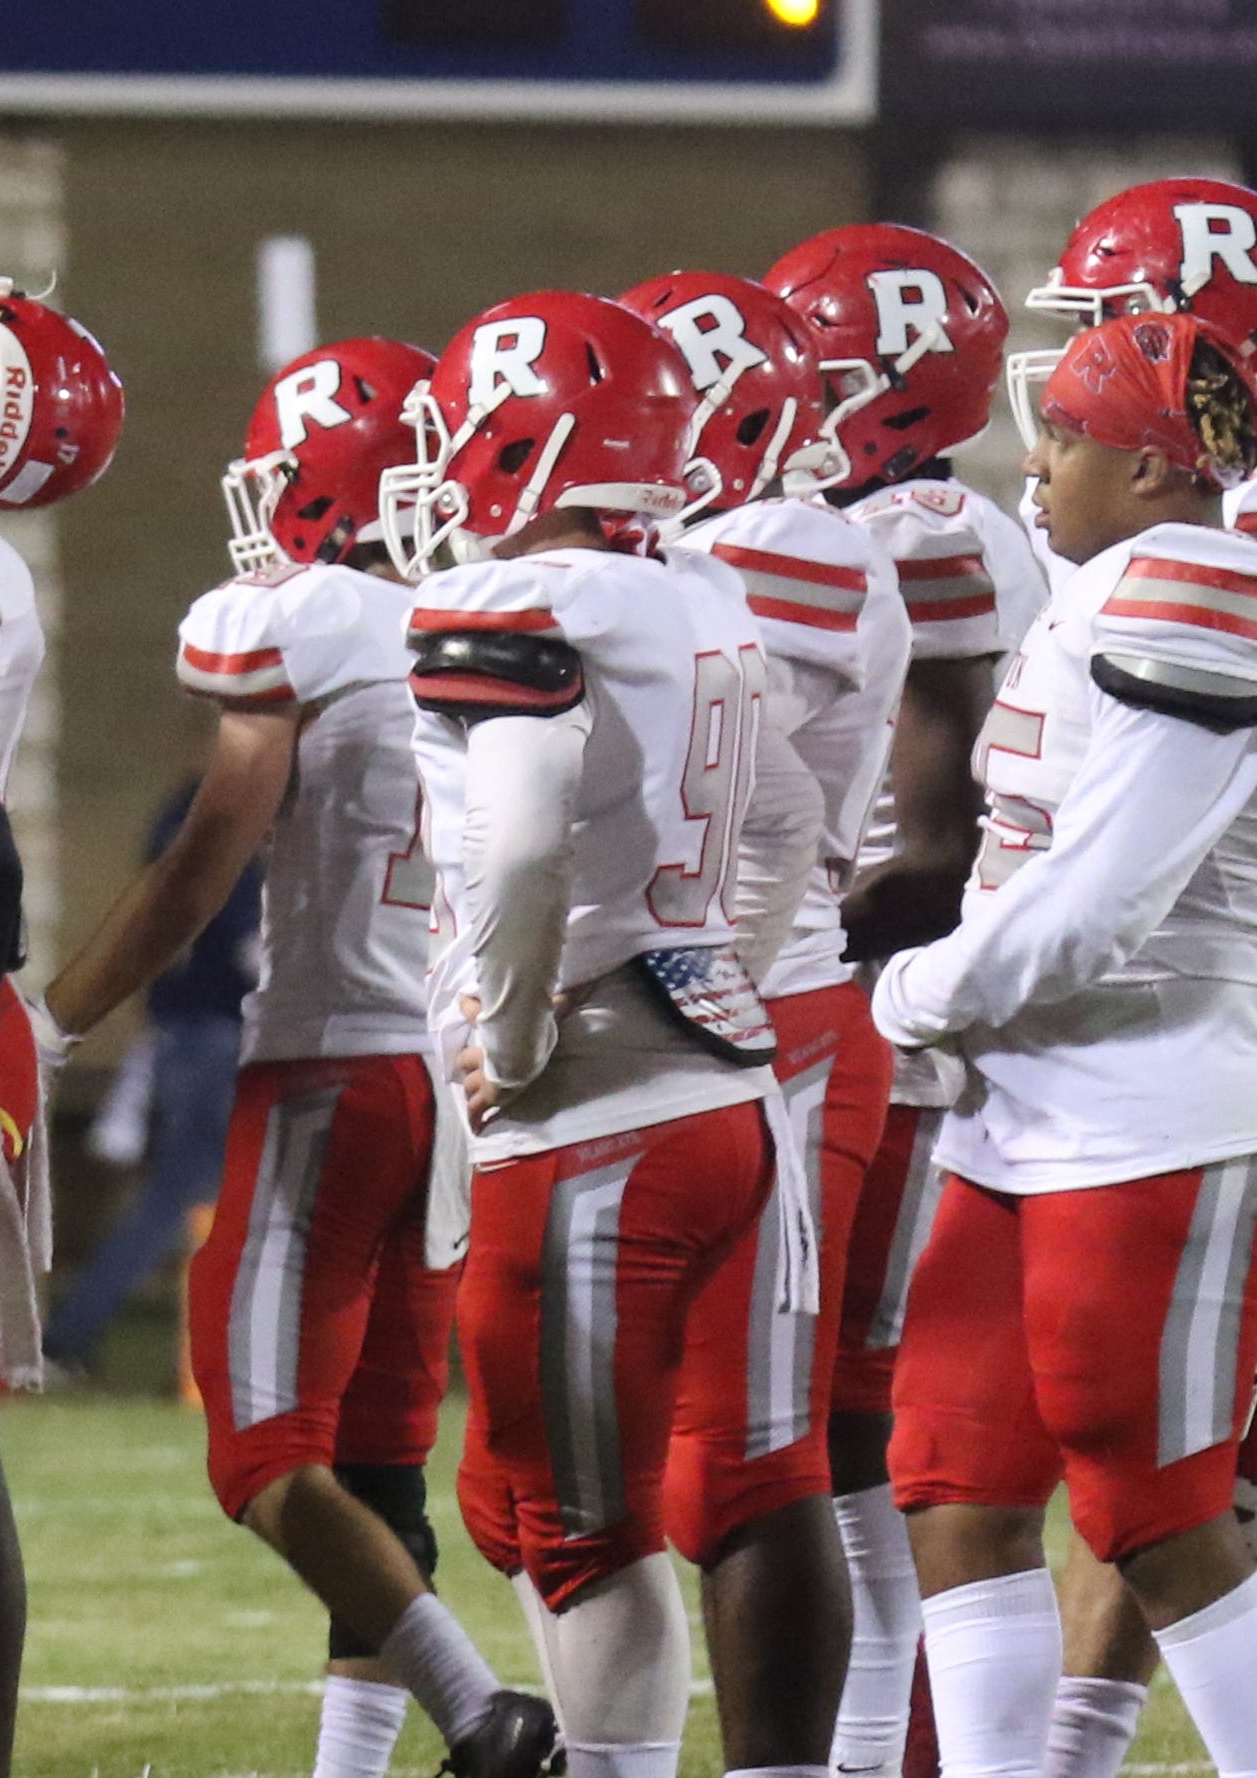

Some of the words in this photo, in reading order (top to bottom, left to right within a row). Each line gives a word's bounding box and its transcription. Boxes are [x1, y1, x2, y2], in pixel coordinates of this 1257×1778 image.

[1173, 203, 1257, 284] R
[656, 294, 767, 391] R
[868, 268, 935, 355] R
[274, 359, 352, 451] R
[469, 316, 548, 405] R
